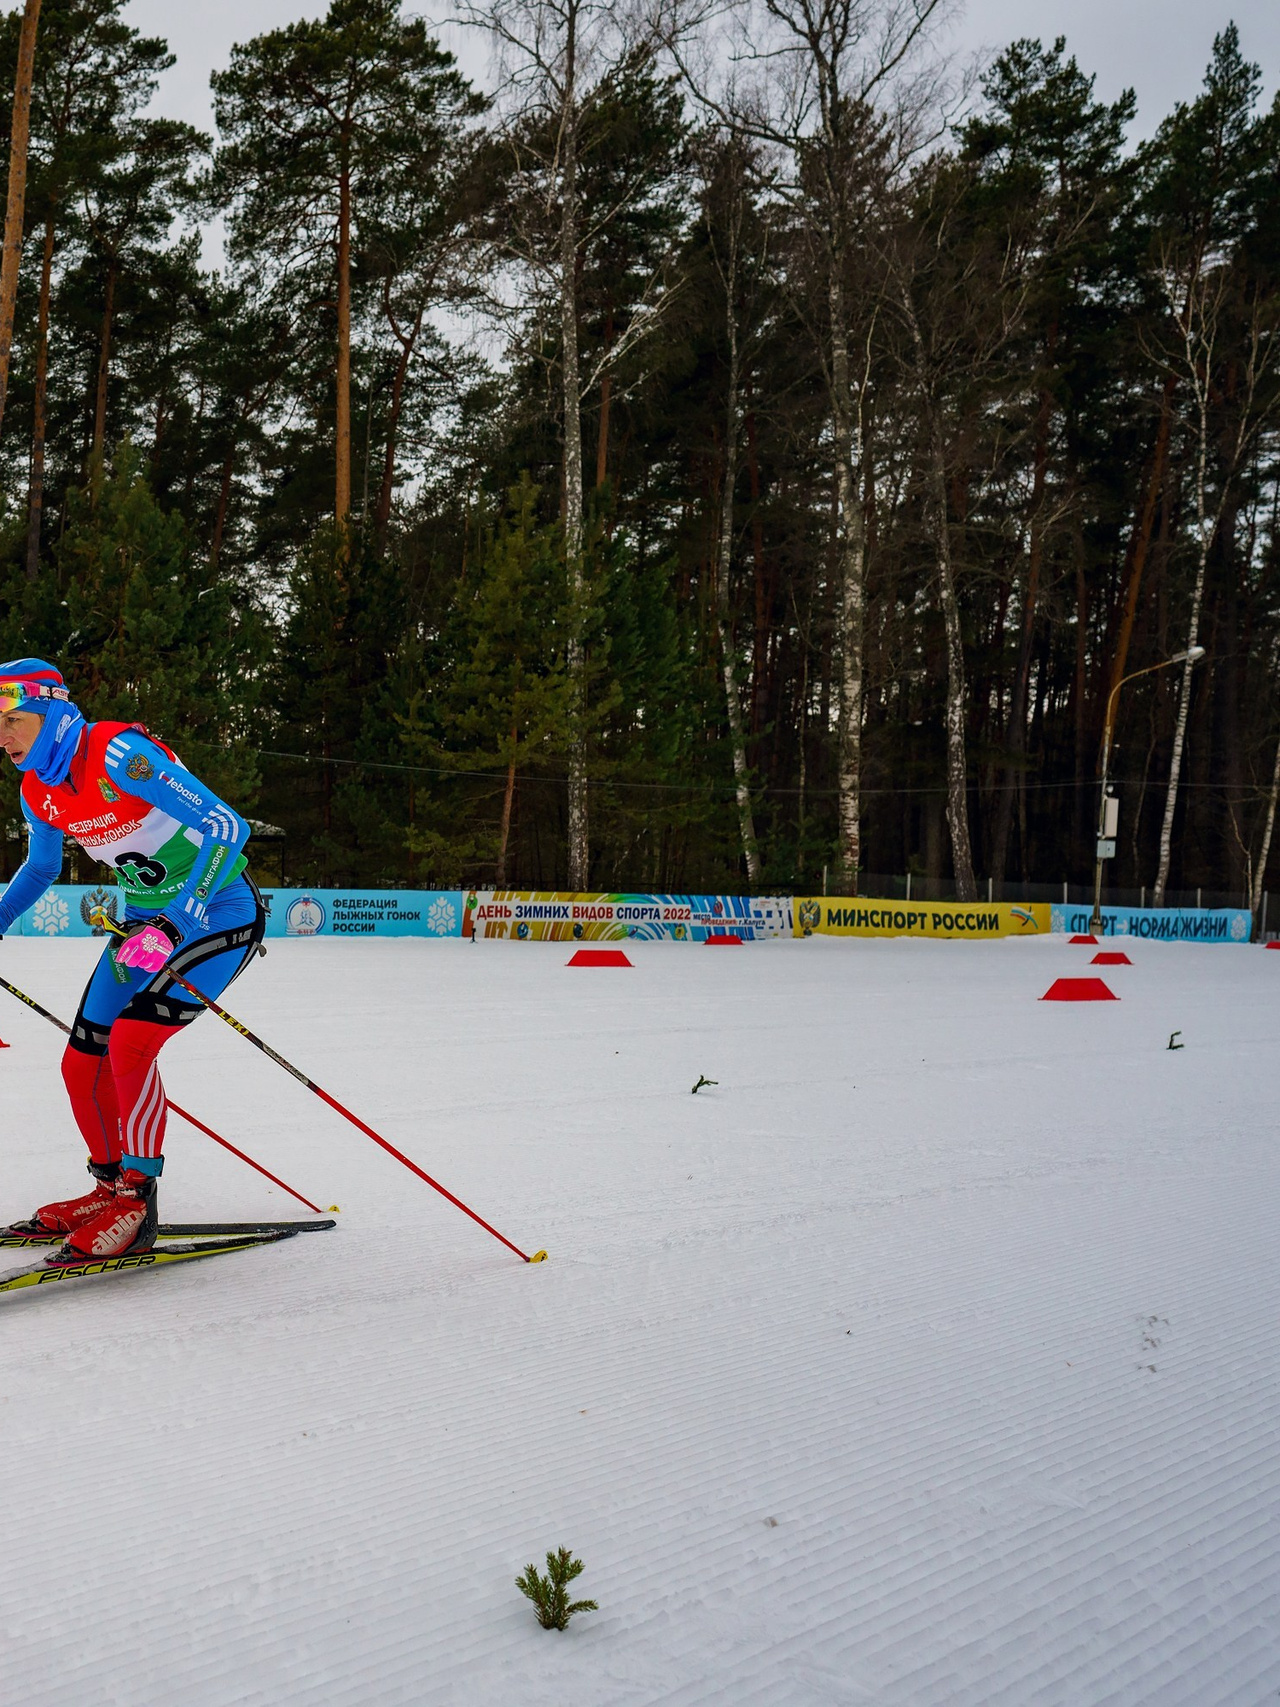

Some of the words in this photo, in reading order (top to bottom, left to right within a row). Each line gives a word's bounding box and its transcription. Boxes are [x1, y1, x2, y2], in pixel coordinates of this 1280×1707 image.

[68, 812, 118, 834] ФЕДЕРАЦИЯ
[105, 819, 141, 844] ГОНОК
[202, 845, 226, 887] МЕГАФОН
[332, 898, 398, 909] ФЕДЕРАЦИЯ
[476, 905, 512, 920] ДЕНЬ
[515, 905, 570, 919] ЗИМНИХ
[572, 906, 614, 920] ВИДОВ
[616, 906, 661, 920] СПОРТА
[663, 908, 691, 921] 2022
[332, 910, 384, 921] ЛЫЖНЫХ
[387, 910, 421, 921] ГОНОК
[827, 908, 927, 930] МИНСПОРТ
[932, 913, 999, 931] РОССИИ
[1070, 913, 1118, 936] СПРТ
[1128, 916, 1179, 937] НОРМА
[1180, 917, 1228, 938] ЖИЗНИ
[332, 922, 376, 933] РОССИИ
[218, 1010, 251, 1036] LEKI
[39, 1255, 156, 1284] FISCHER
